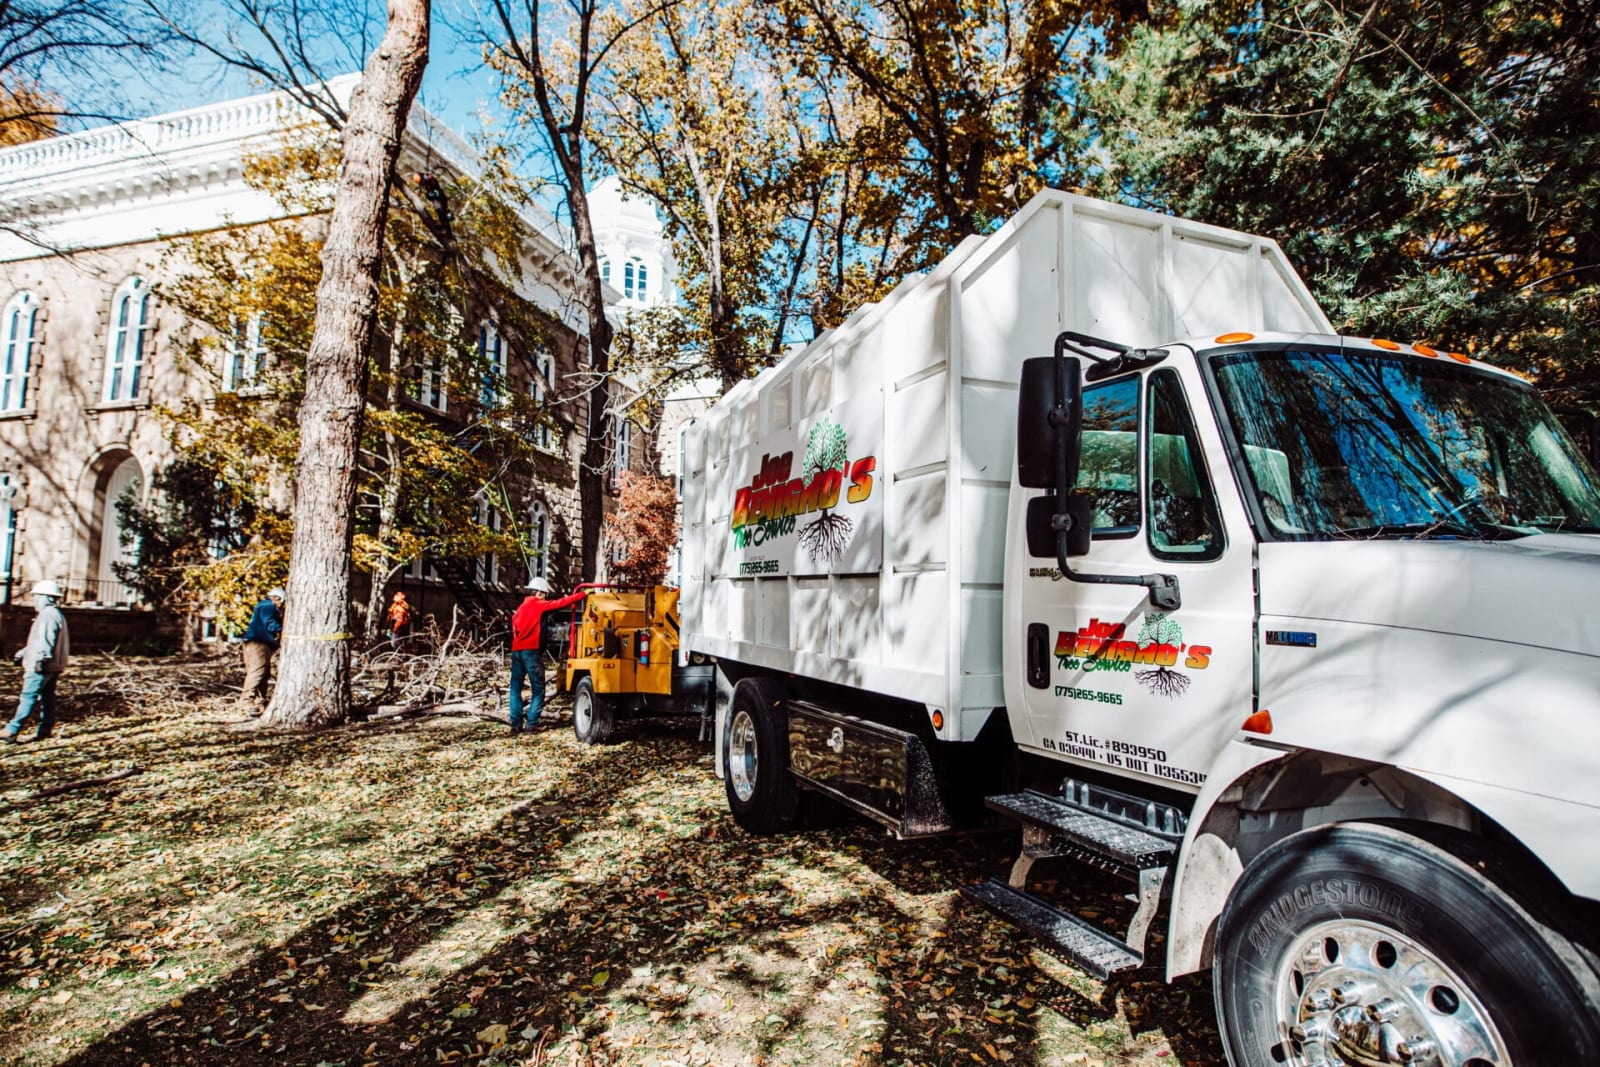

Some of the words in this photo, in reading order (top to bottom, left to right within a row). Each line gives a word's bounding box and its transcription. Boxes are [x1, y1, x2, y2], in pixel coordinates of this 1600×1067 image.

[753, 507, 796, 547] Service
[1054, 631, 1212, 669] BENIGNO'S
[1055, 654, 1080, 672] Tree
[1082, 654, 1132, 672] Service
[1055, 685, 1123, 705] (775)265-9665
[1043, 737, 1056, 750] CA
[1107, 753, 1122, 766] US
[1126, 757, 1149, 772] DOT
[1249, 878, 1425, 958] BRIDGESTONE
